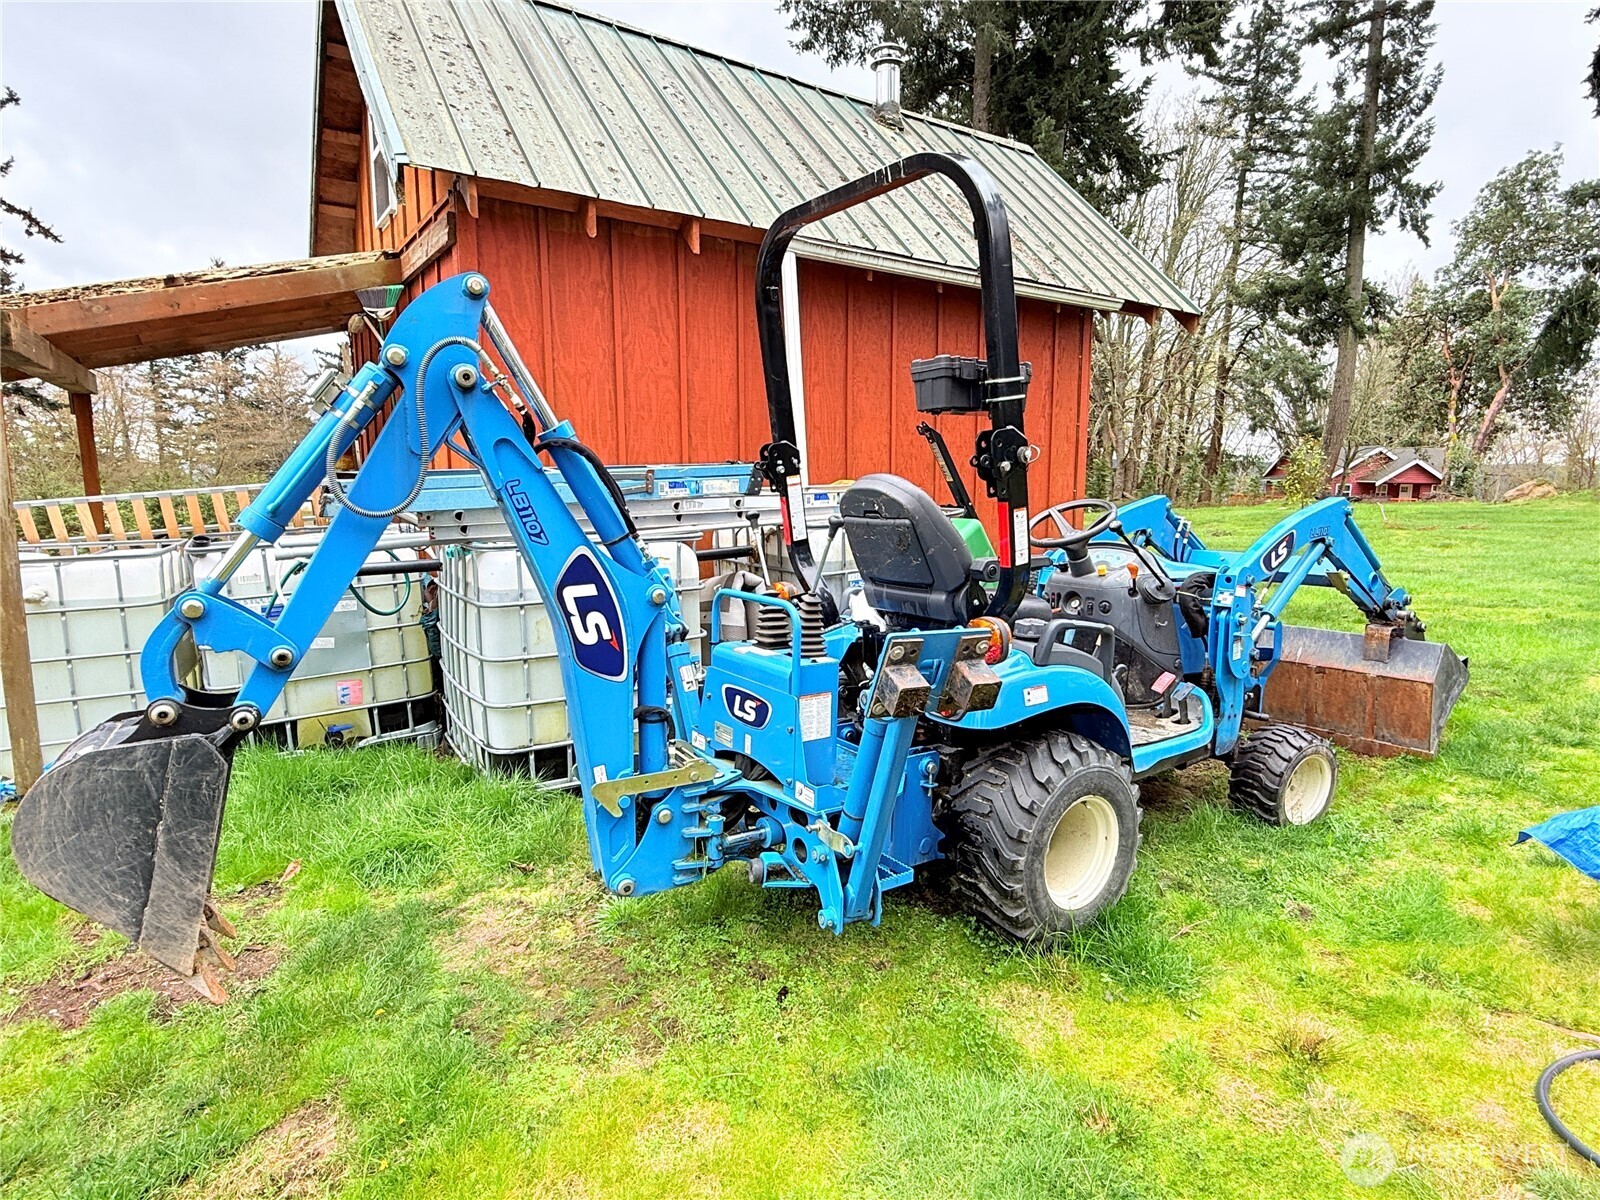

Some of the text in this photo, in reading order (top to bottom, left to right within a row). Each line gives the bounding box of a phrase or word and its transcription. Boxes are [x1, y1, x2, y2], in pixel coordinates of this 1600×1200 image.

[505, 479, 549, 545] LB1107
[1271, 540, 1288, 568] LS
[562, 583, 613, 646] LS
[733, 694, 757, 722] LS
